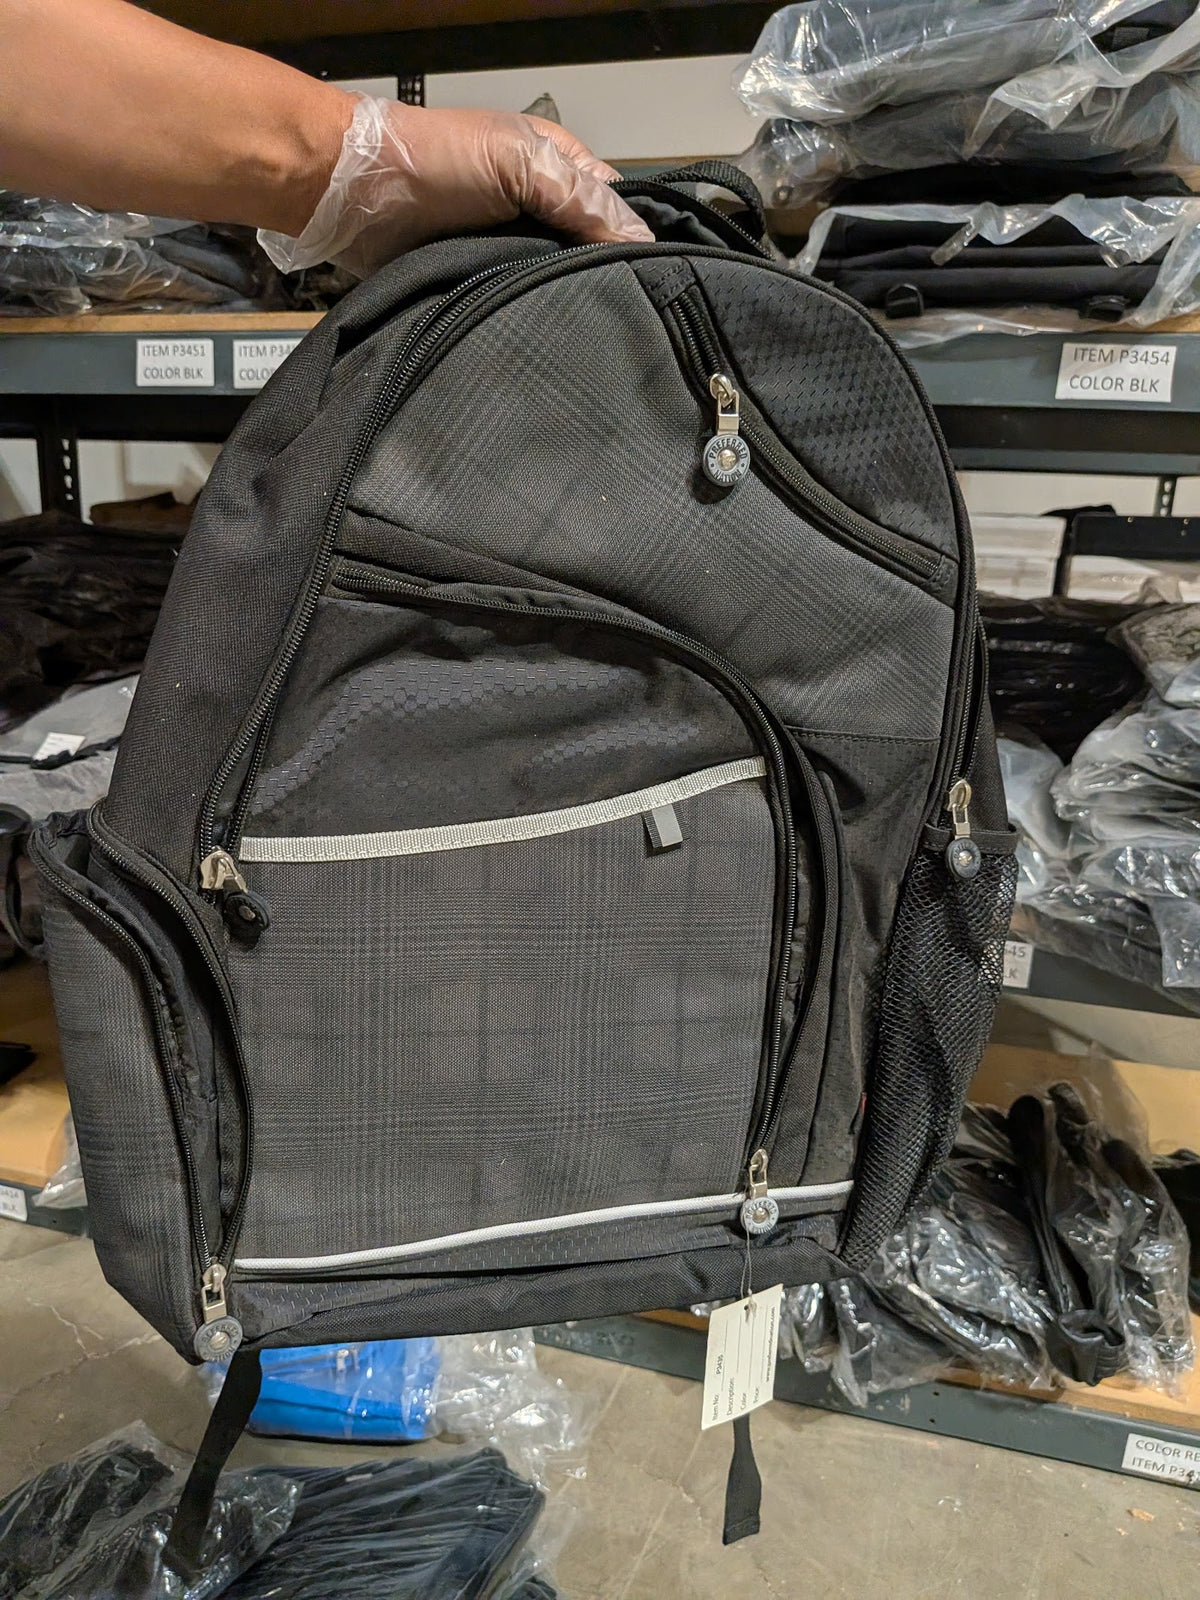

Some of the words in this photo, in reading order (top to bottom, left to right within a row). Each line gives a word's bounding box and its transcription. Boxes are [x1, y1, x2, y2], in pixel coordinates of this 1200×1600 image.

[142, 344, 170, 357] ITEM
[172, 344, 206, 357] P3451
[239, 344, 267, 358] ITEM
[1073, 347, 1114, 364] ITEM
[1119, 349, 1170, 366] P3454
[143, 367, 182, 380] COLOR
[184, 368, 204, 380] BLK
[239, 367, 274, 381] COLO
[1069, 375, 1124, 392] COLOR
[1129, 378, 1160, 393] BLK
[709, 438, 748, 459] PREFERRED
[1136, 1440, 1180, 1457] COLOR
[1132, 1457, 1165, 1472] ITEM
